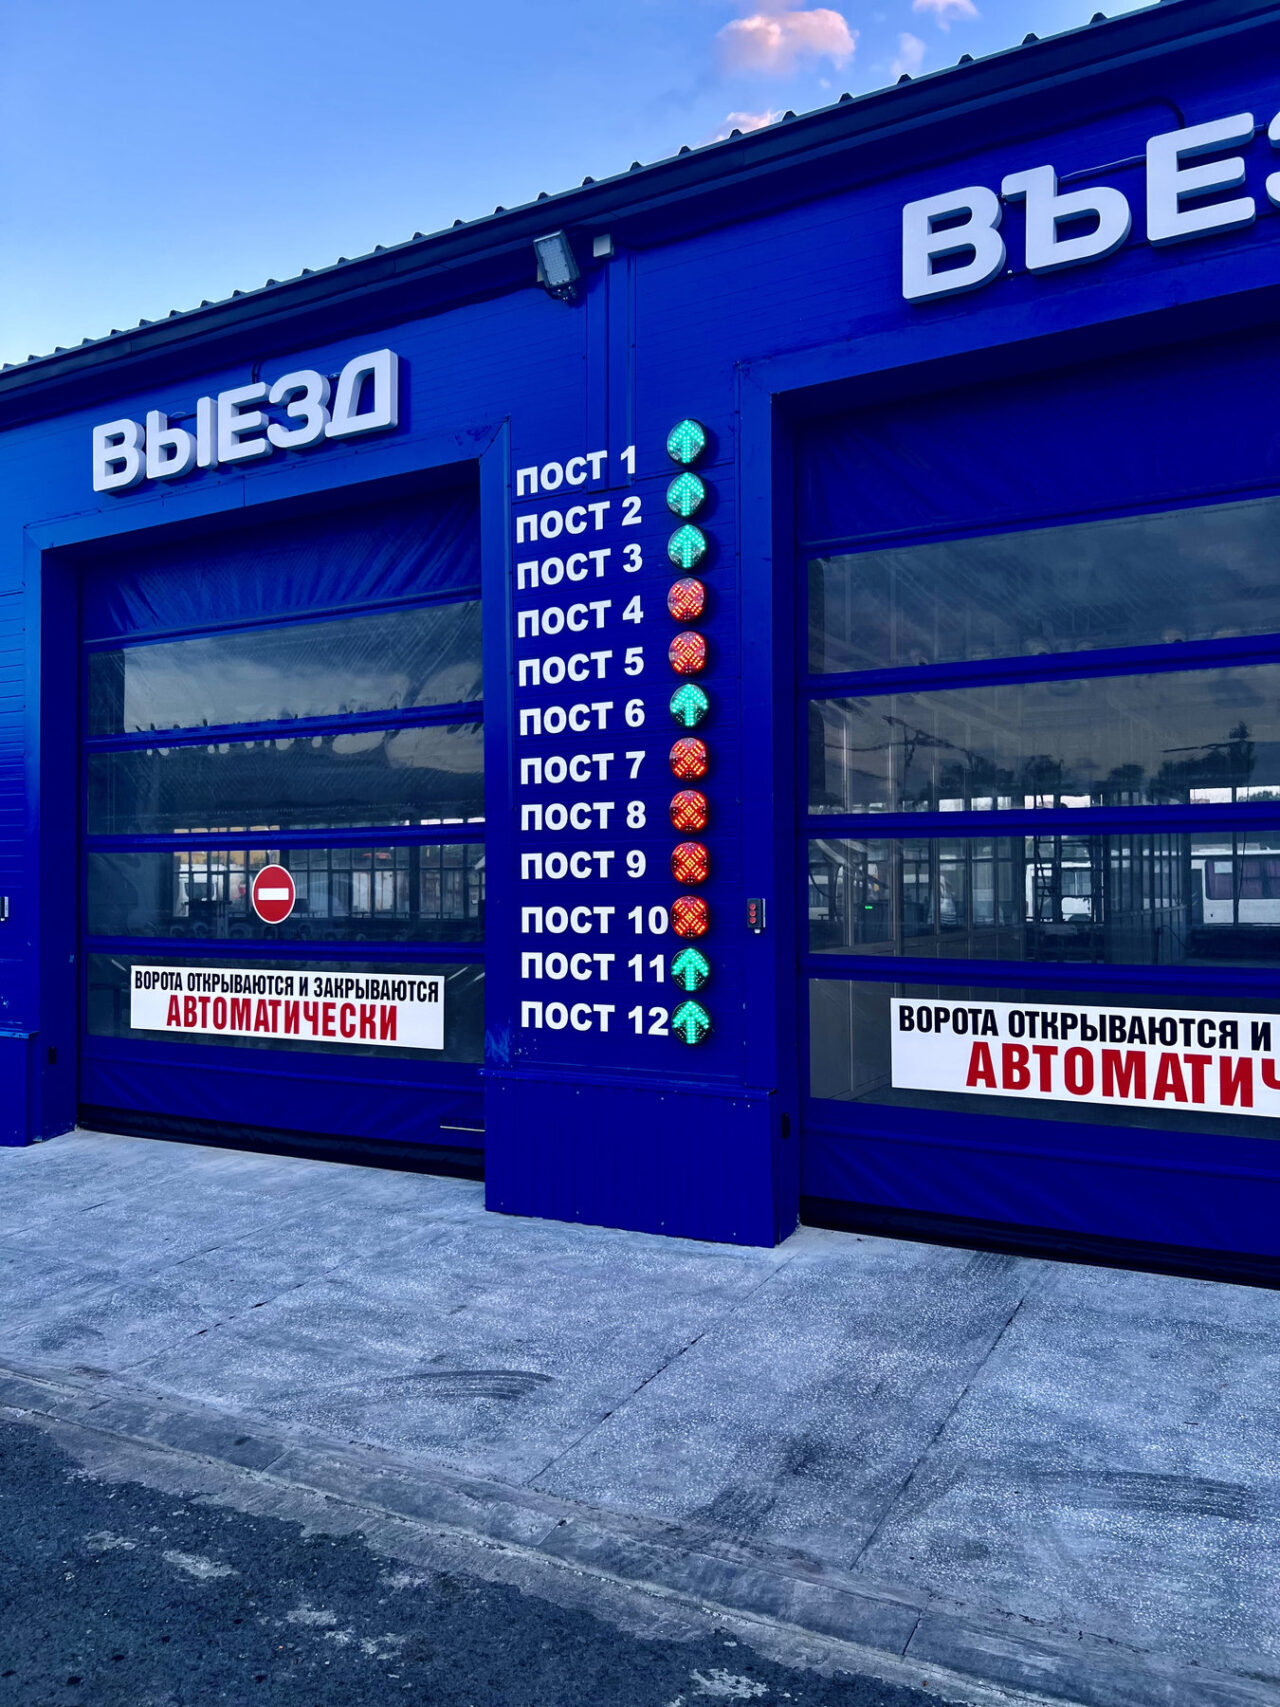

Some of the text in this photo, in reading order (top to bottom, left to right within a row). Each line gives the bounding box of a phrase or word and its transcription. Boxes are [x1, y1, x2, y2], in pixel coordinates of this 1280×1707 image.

[902, 111, 1280, 302] ВЪЕ
[92, 348, 399, 493] ВЫЕЗД
[516, 445, 636, 497] ПОСТ 1
[516, 495, 642, 544] ПОСТ 2
[517, 543, 643, 590] ПОСТ 3
[517, 594, 644, 639] ПОСТ 4
[518, 646, 645, 687] ПОСТ 5
[519, 698, 646, 736] ПОСТ 6
[520, 750, 646, 785] ПОСТ 7
[521, 800, 647, 831] ПОСТ 8
[521, 849, 647, 880] ПОСТ 9
[521, 905, 669, 935] ПОСТ 10
[135, 970, 439, 1003] ВОРОТА ОТКРЫВАЮТСЯ И ЗАКРЫВАЮТСЯ
[521, 951, 665, 983] ПОСТ 11
[166, 994, 397, 1041] АВТОМАТИЧЕСКИ
[521, 1000, 669, 1036] ПОСТ 12
[899, 1005, 1272, 1052] ВОРОТА ОТКРЫВАЮТСЯ И
